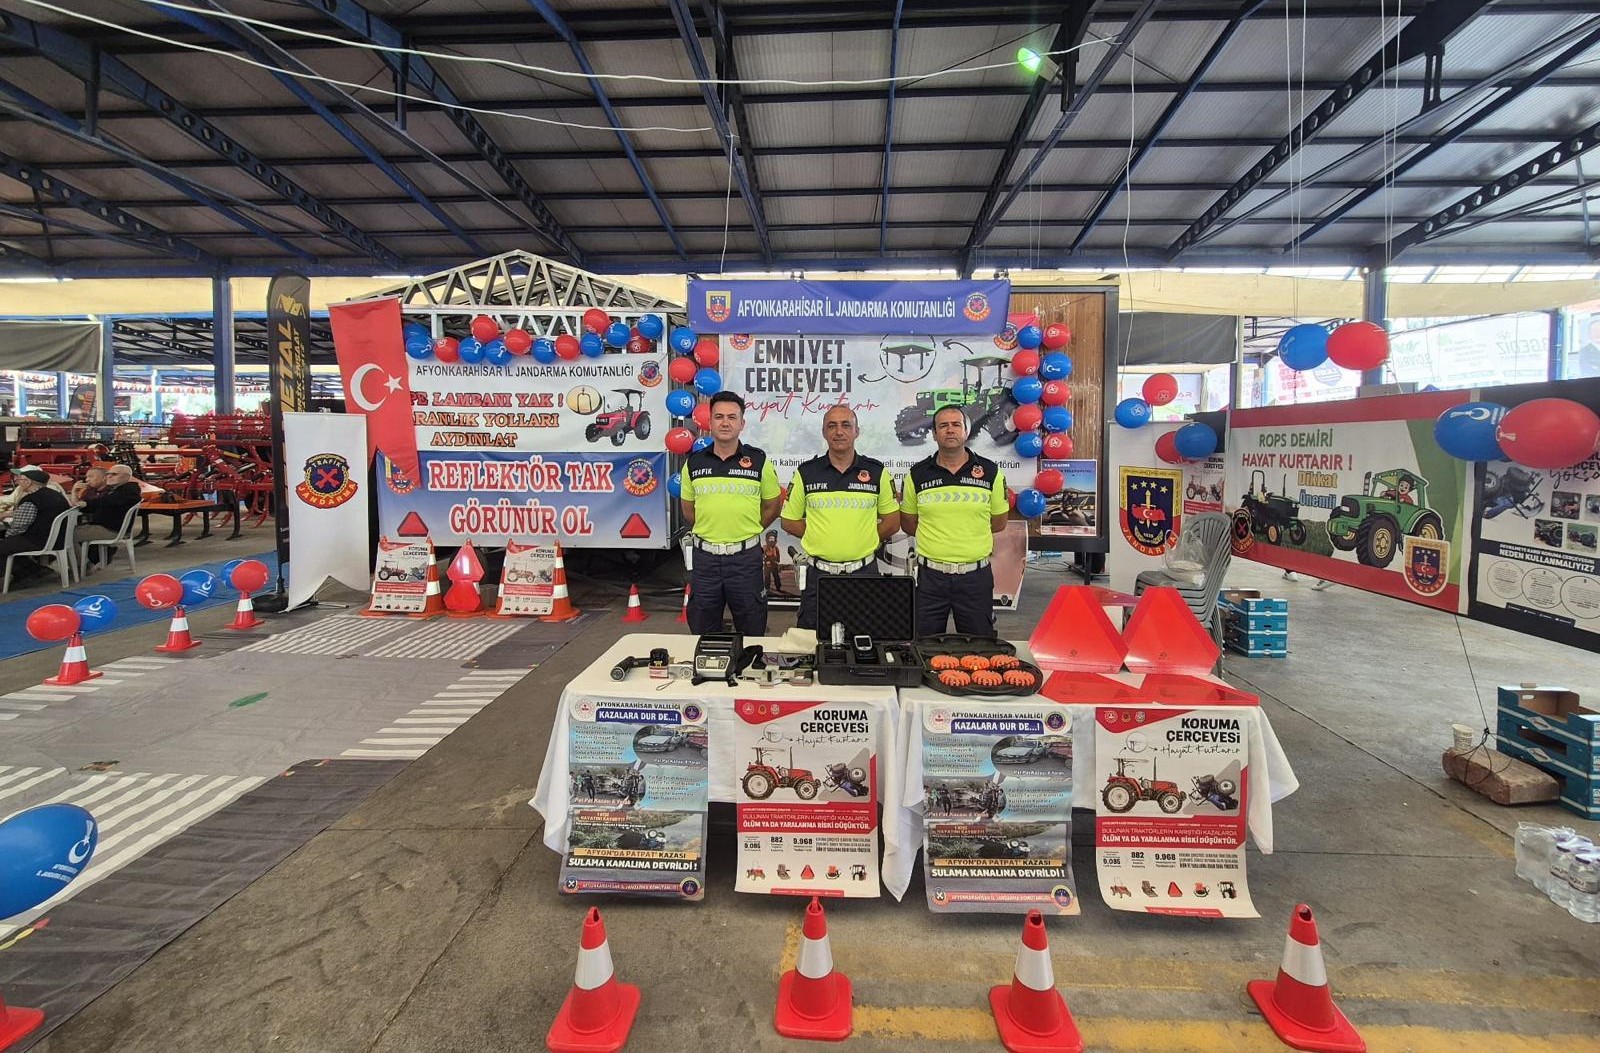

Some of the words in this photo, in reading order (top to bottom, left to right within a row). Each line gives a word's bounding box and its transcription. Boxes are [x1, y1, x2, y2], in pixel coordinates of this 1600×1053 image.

[737, 296, 823, 318] AFYONKARAHİSAR
[825, 298, 834, 317] İL
[835, 300, 889, 318] JANDARMA
[890, 296, 955, 318] KOMUTANLIĞI
[754, 334, 845, 364] EMNİYET
[416, 363, 502, 377] AFYONKARAHİSAR
[515, 364, 567, 378] JANDARMA
[569, 364, 634, 378] KOMUTANLIĞI
[745, 363, 852, 392] ÇERÇEVESİ
[432, 392, 512, 407] LAMBANI
[515, 393, 554, 407] YAK
[557, 392, 564, 407] !
[484, 412, 560, 428] YOLLARI
[430, 432, 518, 447] AYDINLAT
[1259, 433, 1287, 448] ROPS
[1290, 428, 1333, 448] DEMİRİ
[1242, 453, 1276, 467] HAYAT
[1279, 454, 1343, 471] KURTARIR
[428, 456, 561, 492] REFLEKTÖR
[568, 462, 613, 492] TAK
[1298, 470, 1338, 488] Dikkat
[297, 483, 357, 506] JANDARMA
[1299, 489, 1337, 509] Önemli
[450, 500, 556, 536] GÖRÜNÜR
[561, 504, 592, 535] OL
[1499, 549, 1525, 560] NEDEN
[1526, 554, 1595, 573] KULLANMALIYIZ?
[599, 711, 639, 720] KAZALARA
[641, 712, 656, 720] DUR
[814, 710, 868, 721] KORUMA
[800, 722, 869, 734] ÇERÇEVESİ
[955, 721, 998, 730] KAZALARA
[999, 721, 1017, 731] DUR
[1181, 718, 1240, 730] KORUMA
[1166, 730, 1241, 743] ÇERÇEVESİ
[743, 820, 761, 828] ÖLÜM
[780, 821, 817, 829] YARALANMA
[1102, 834, 1121, 843] ÖLÜM
[1182, 836, 1199, 844] RİSKİ
[568, 858, 604, 866] SULAMA
[606, 860, 650, 869] KANALINA
[652, 861, 692, 870] DEVRİLDİ
[931, 868, 969, 877] SULAMA
[970, 869, 1016, 877] KANALINA
[1018, 868, 1059, 877] DEVRİLDİ
